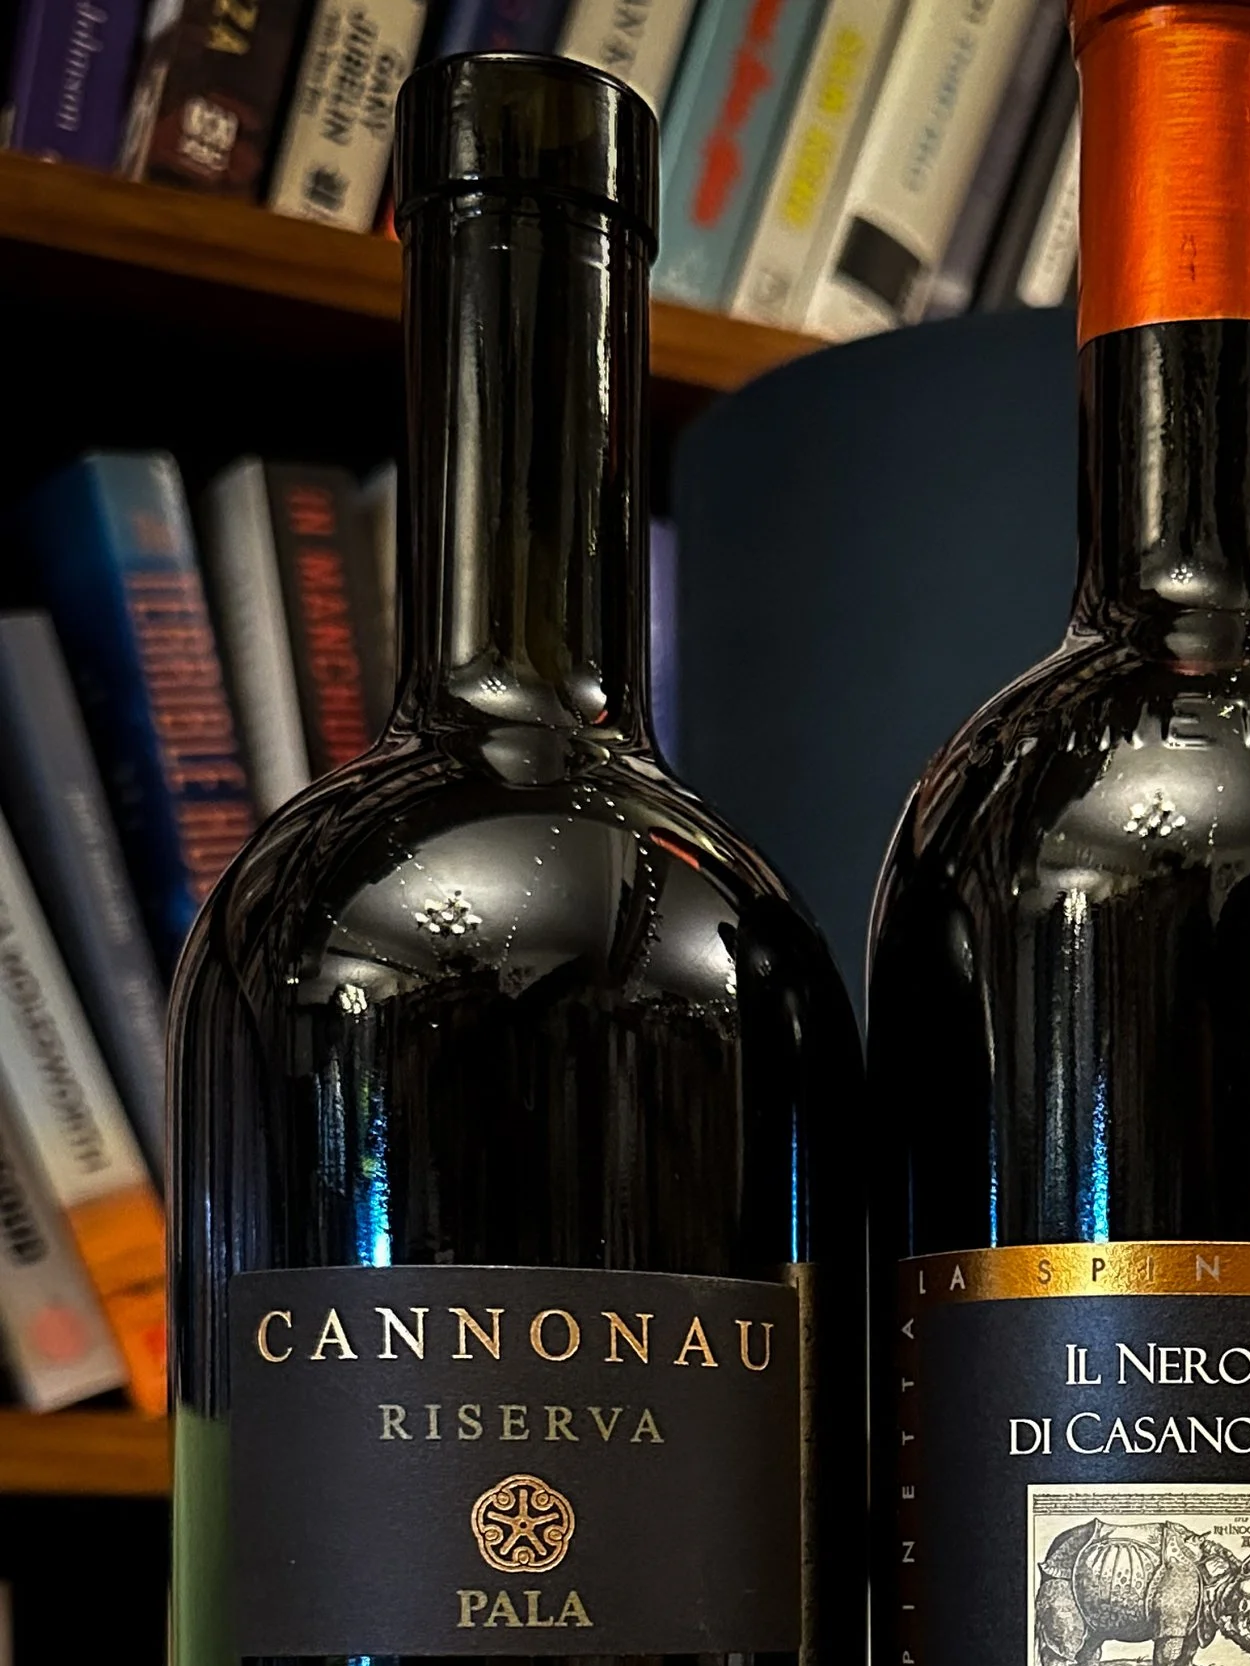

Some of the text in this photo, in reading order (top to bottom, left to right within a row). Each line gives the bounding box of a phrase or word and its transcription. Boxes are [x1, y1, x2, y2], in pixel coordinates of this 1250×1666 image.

[918, 1265, 967, 1296] LA
[256, 1306, 774, 1372] CANNONAU
[380, 1404, 665, 1444] RISERVA
[1009, 1419, 1052, 1456] DI
[456, 1589, 594, 1628] PALA
